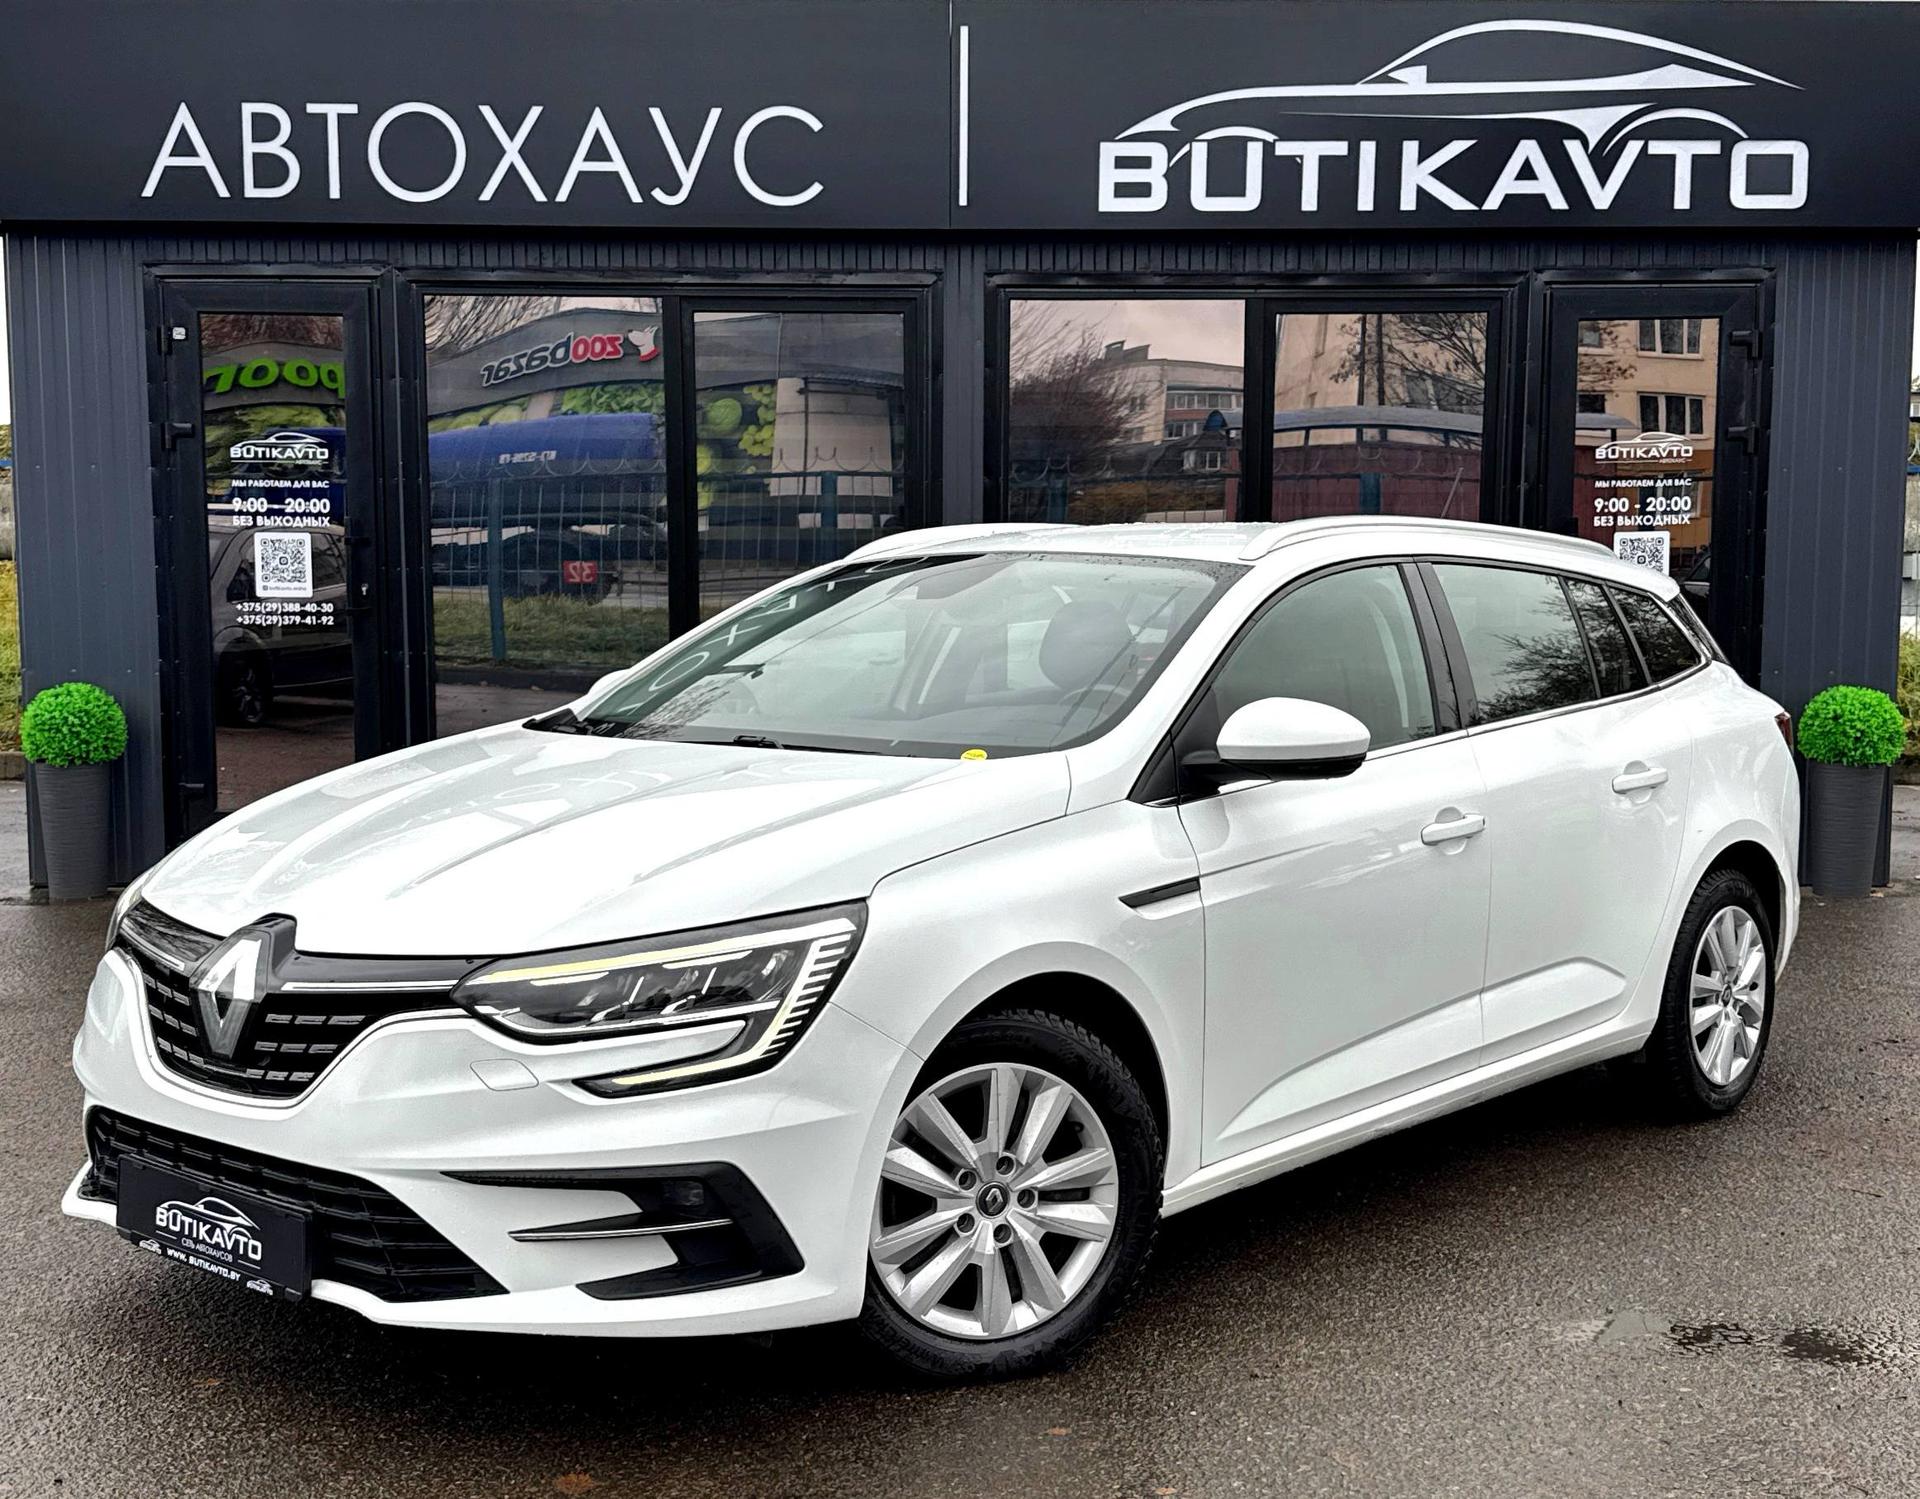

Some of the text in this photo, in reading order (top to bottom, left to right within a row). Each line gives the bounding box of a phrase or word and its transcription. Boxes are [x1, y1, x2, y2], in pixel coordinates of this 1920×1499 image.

[141, 101, 825, 207] АВТОХАУС
[1097, 138, 1810, 213] BUTIKAVTO
[230, 447, 329, 459] BUTIKAVTO
[1594, 446, 1693, 459] BUTIKAVTO
[231, 479, 330, 488] МЫ РАБОТАЕМ ДЛЯ ВАС
[1594, 478, 1692, 488] МЫ РАБОТАЕМ ДЛЯ ВАС
[232, 497, 268, 513] 9:00
[284, 498, 330, 513] 20:00
[1594, 497, 1629, 513] 9:00
[1645, 496, 1692, 512] 20:00
[232, 515, 331, 528] БЕЗ ВЫХОДНЫХ
[1593, 514, 1691, 527] БЕЗ ВЫХОДНЫХ
[155, 1206, 262, 1261] BUTIKAVTO
